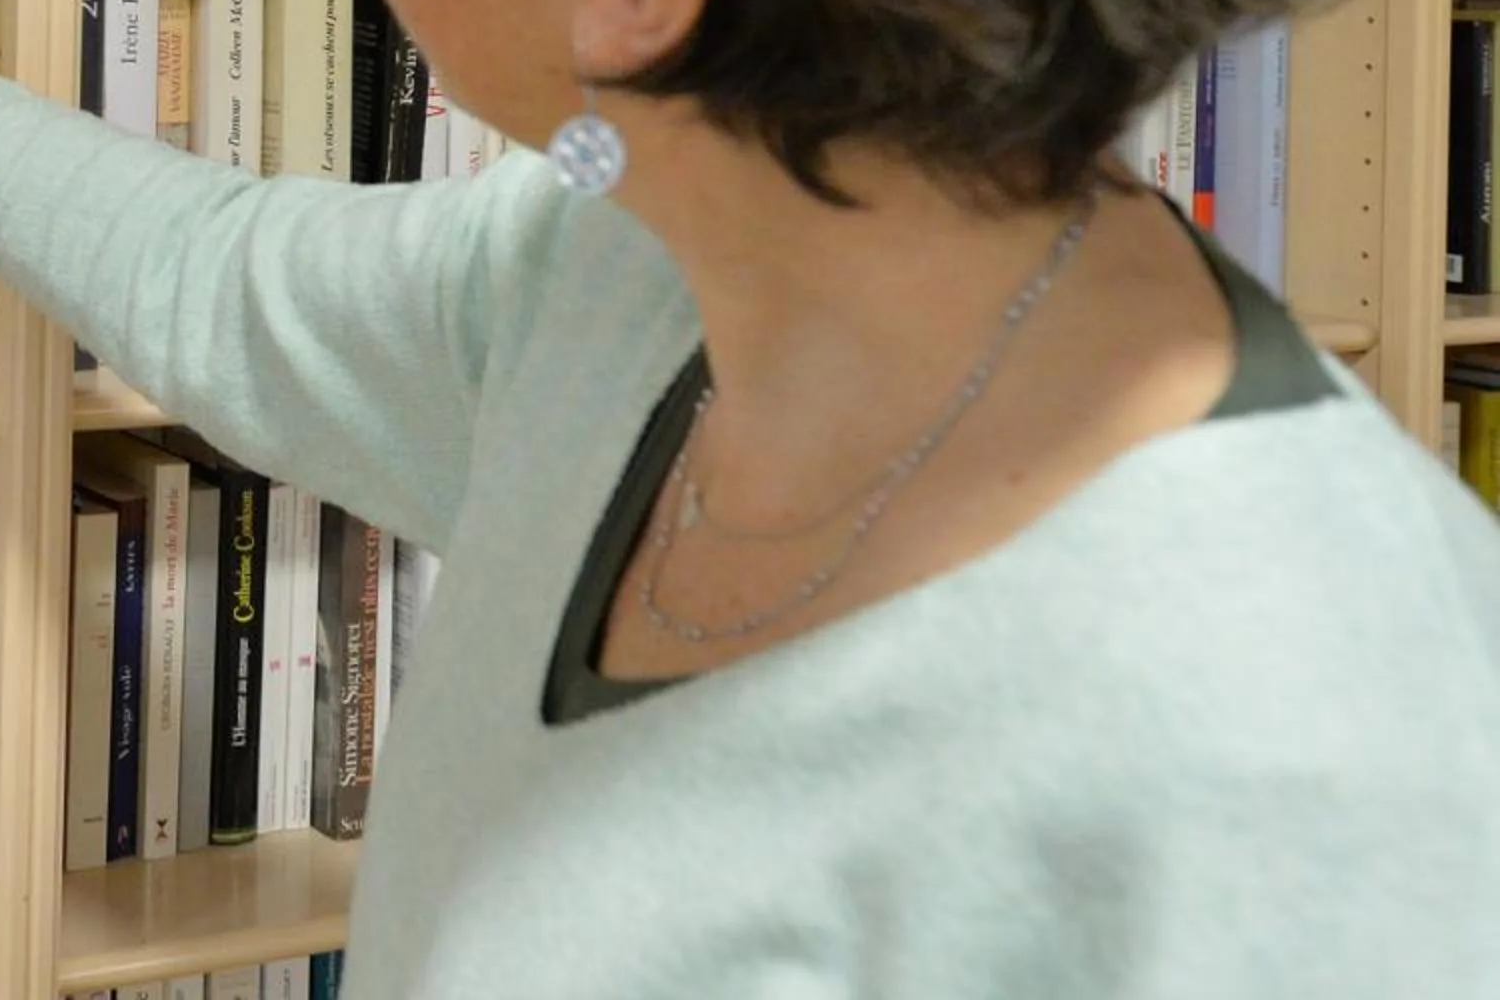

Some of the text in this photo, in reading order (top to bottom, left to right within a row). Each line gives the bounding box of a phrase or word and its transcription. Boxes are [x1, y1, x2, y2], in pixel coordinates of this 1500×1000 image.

[122, 14, 139, 65] Irène
[398, 46, 420, 105] Kevin
[232, 488, 256, 622] Catherine Cookson
[340, 622, 362, 787] Simone Signoret
